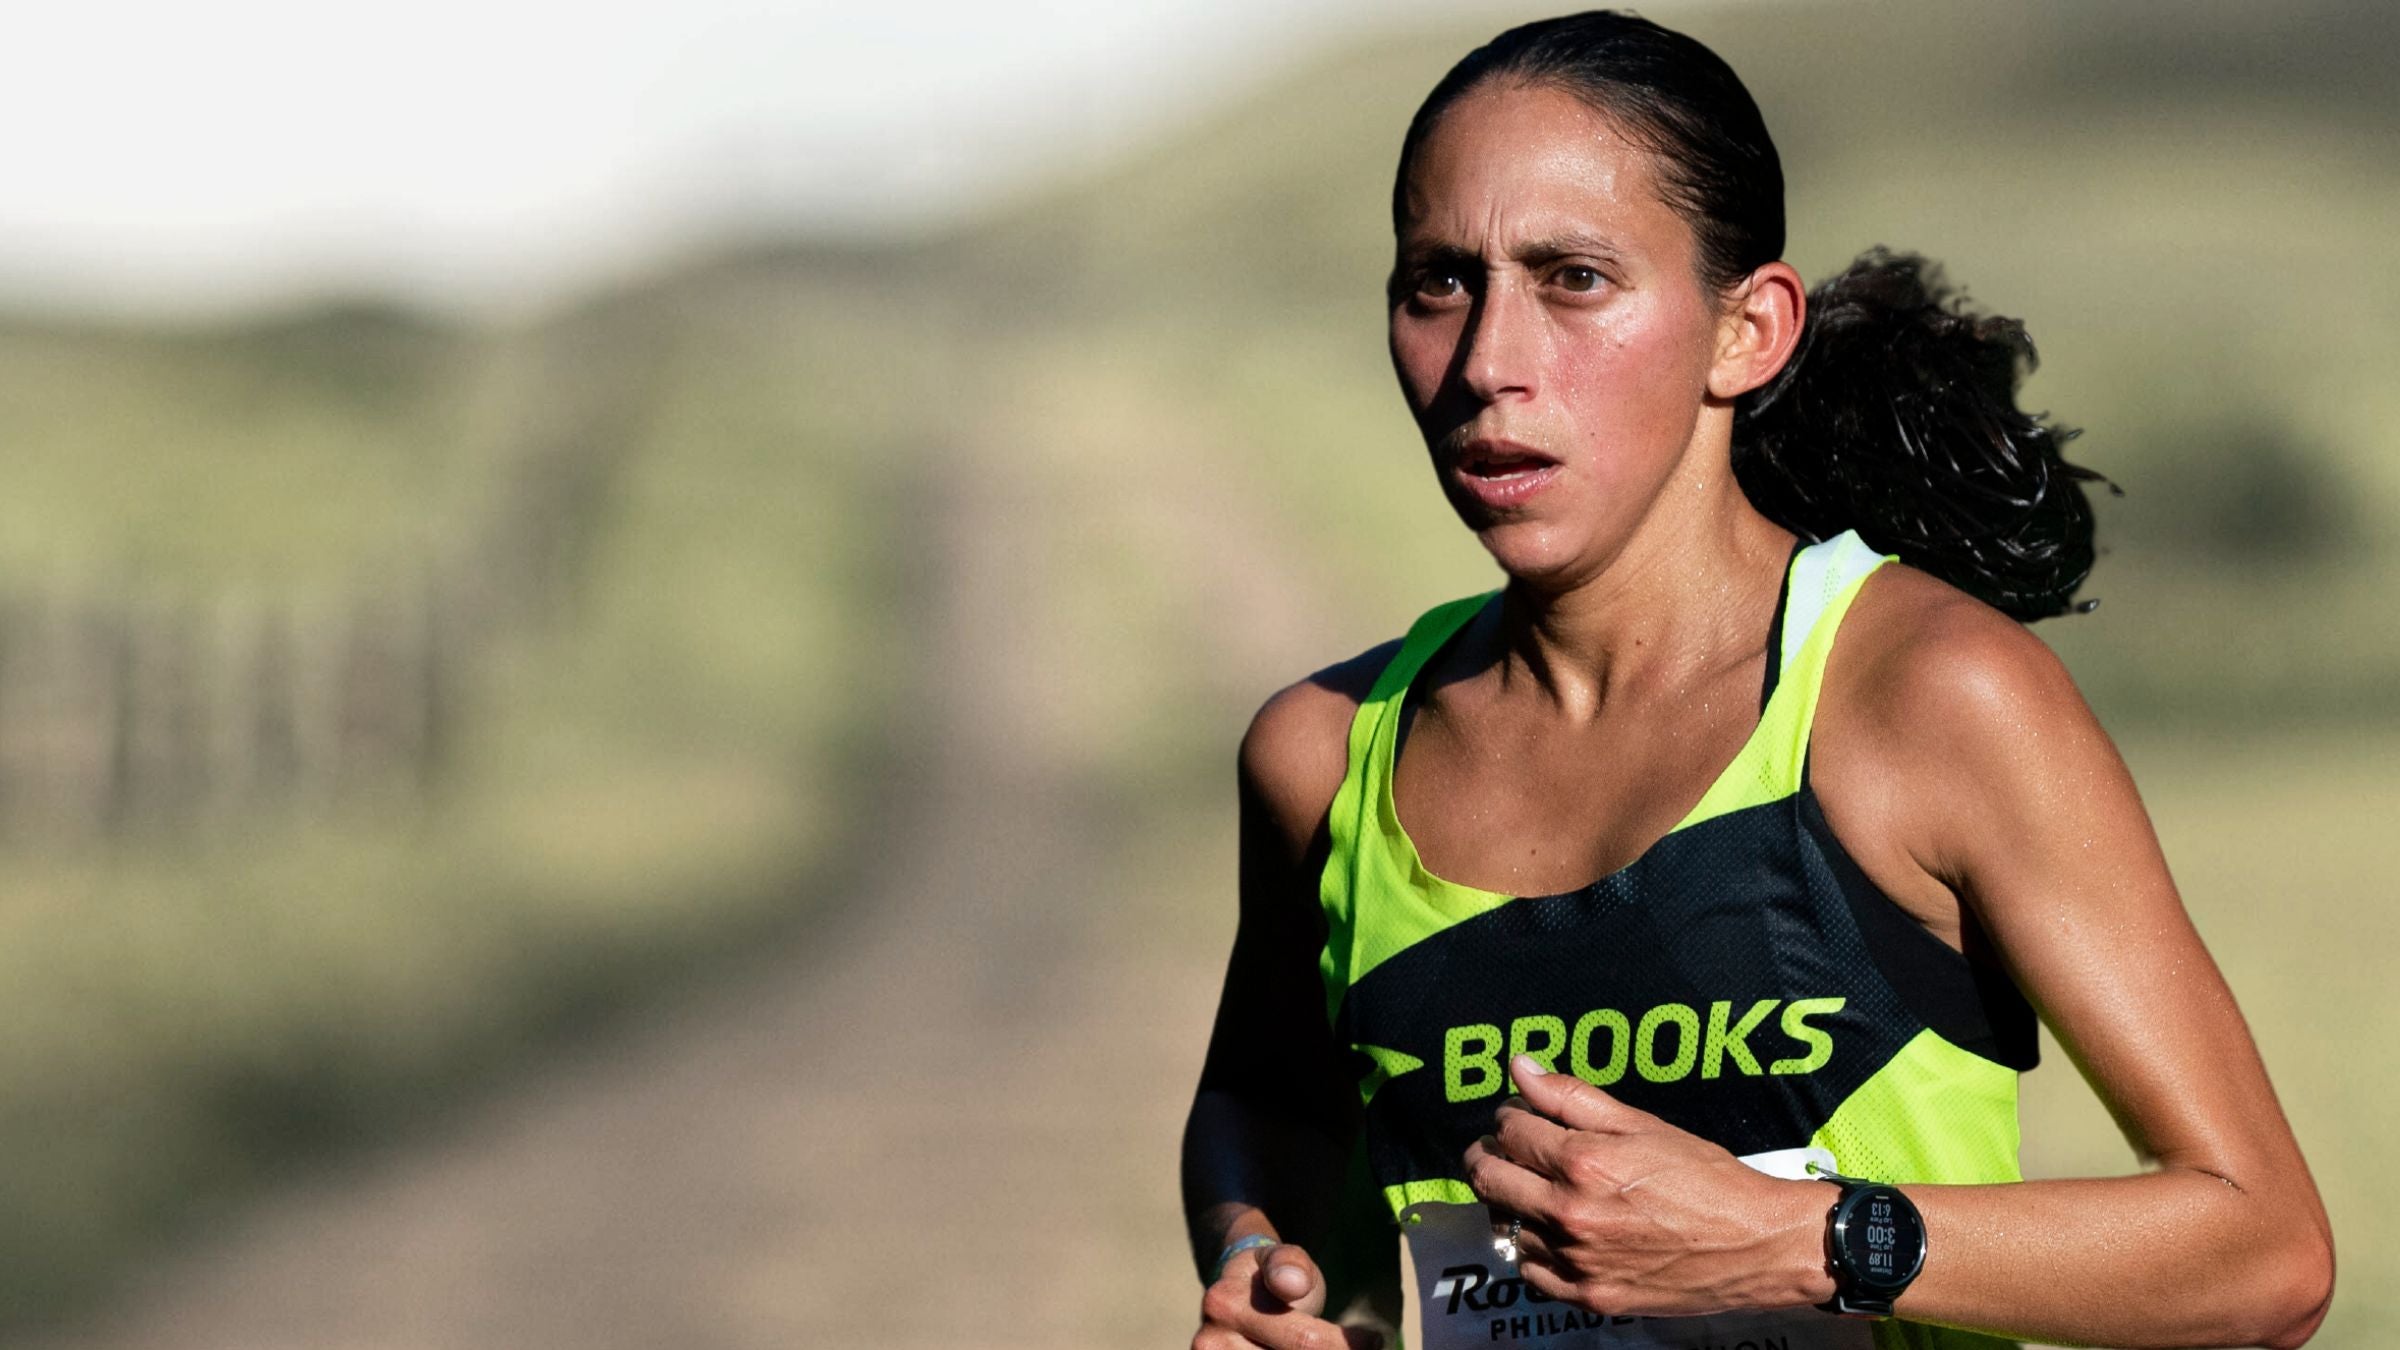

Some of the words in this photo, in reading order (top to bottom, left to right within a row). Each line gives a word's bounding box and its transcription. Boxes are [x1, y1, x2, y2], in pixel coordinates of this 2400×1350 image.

[1444, 997, 1846, 1103] BROOKS
[1872, 1203, 1891, 1216] 6:13
[1867, 1226, 1896, 1244] 3:00
[1868, 1253, 1893, 1267] 11.89
